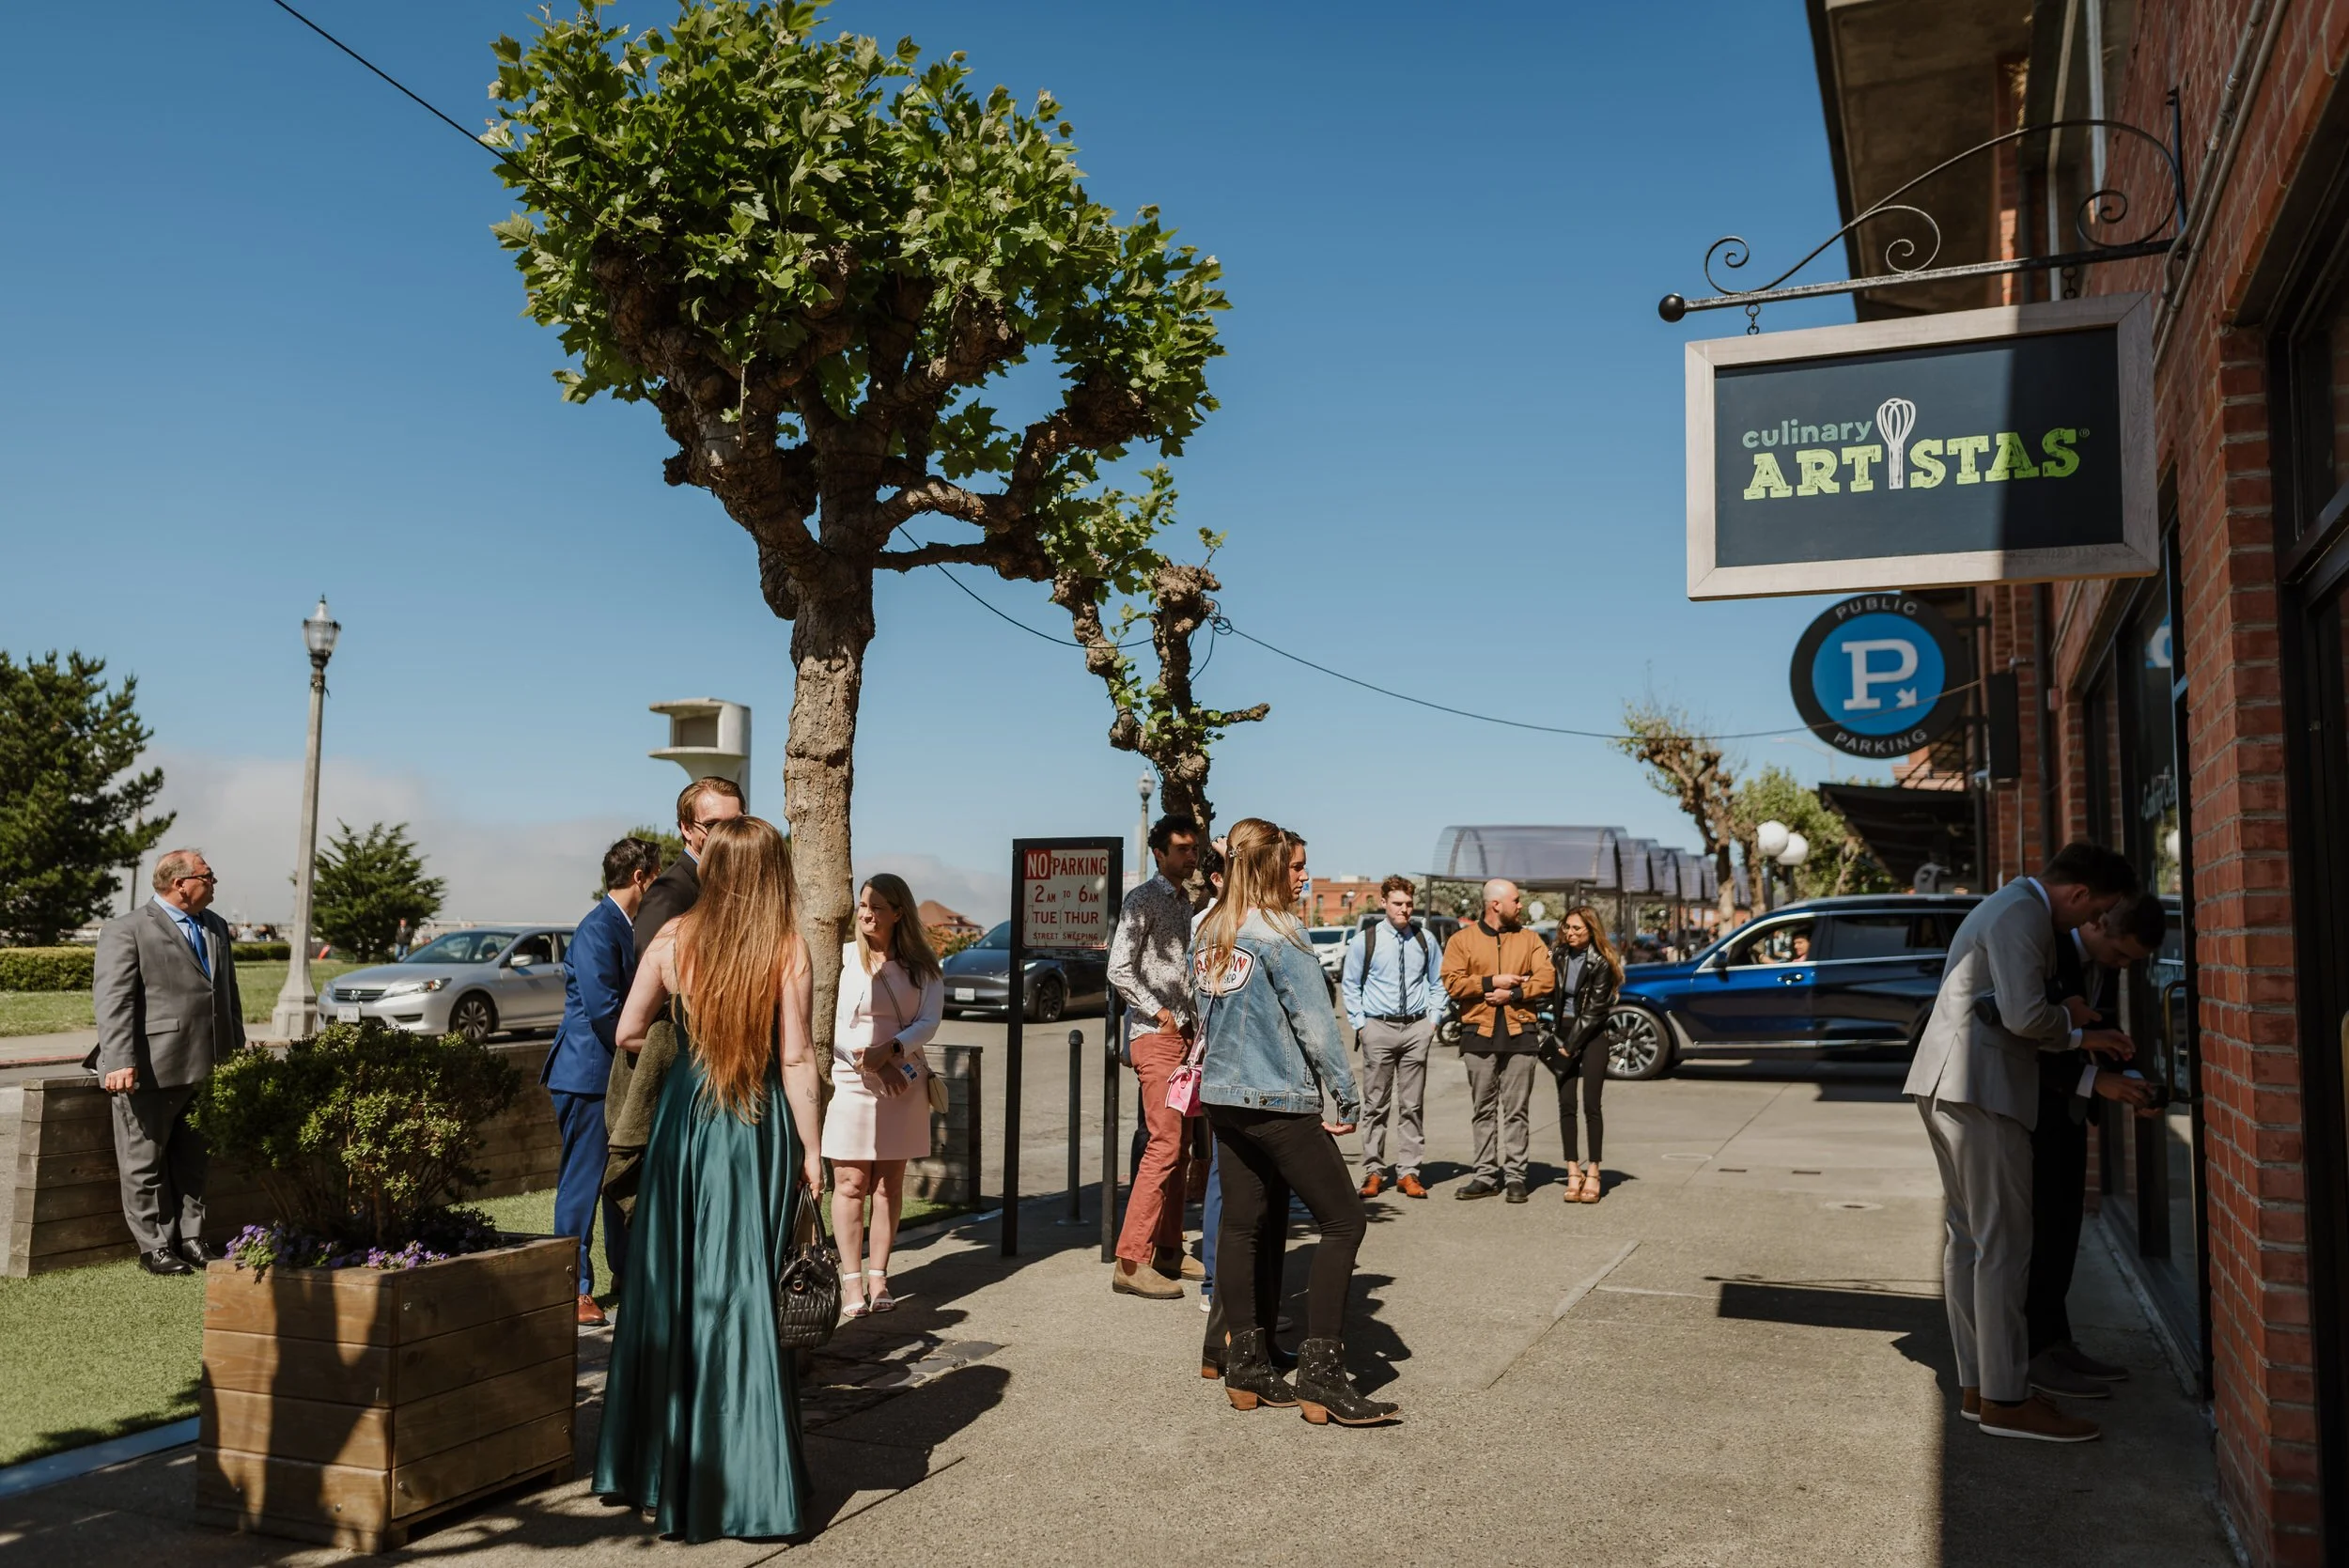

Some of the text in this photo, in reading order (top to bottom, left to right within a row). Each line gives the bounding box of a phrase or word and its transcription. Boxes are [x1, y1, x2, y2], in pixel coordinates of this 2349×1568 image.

[1742, 417, 1873, 449] culinary
[1835, 597, 1918, 620] PUBLIC
[1841, 638, 1919, 711] P
[1833, 728, 1928, 753] PARKING
[1027, 853, 1107, 877] NO PARKING
[1063, 890, 1071, 899] TO
[1034, 911, 1098, 924] TUE THUR
[1034, 931, 1098, 940] STREET SWEEPING
